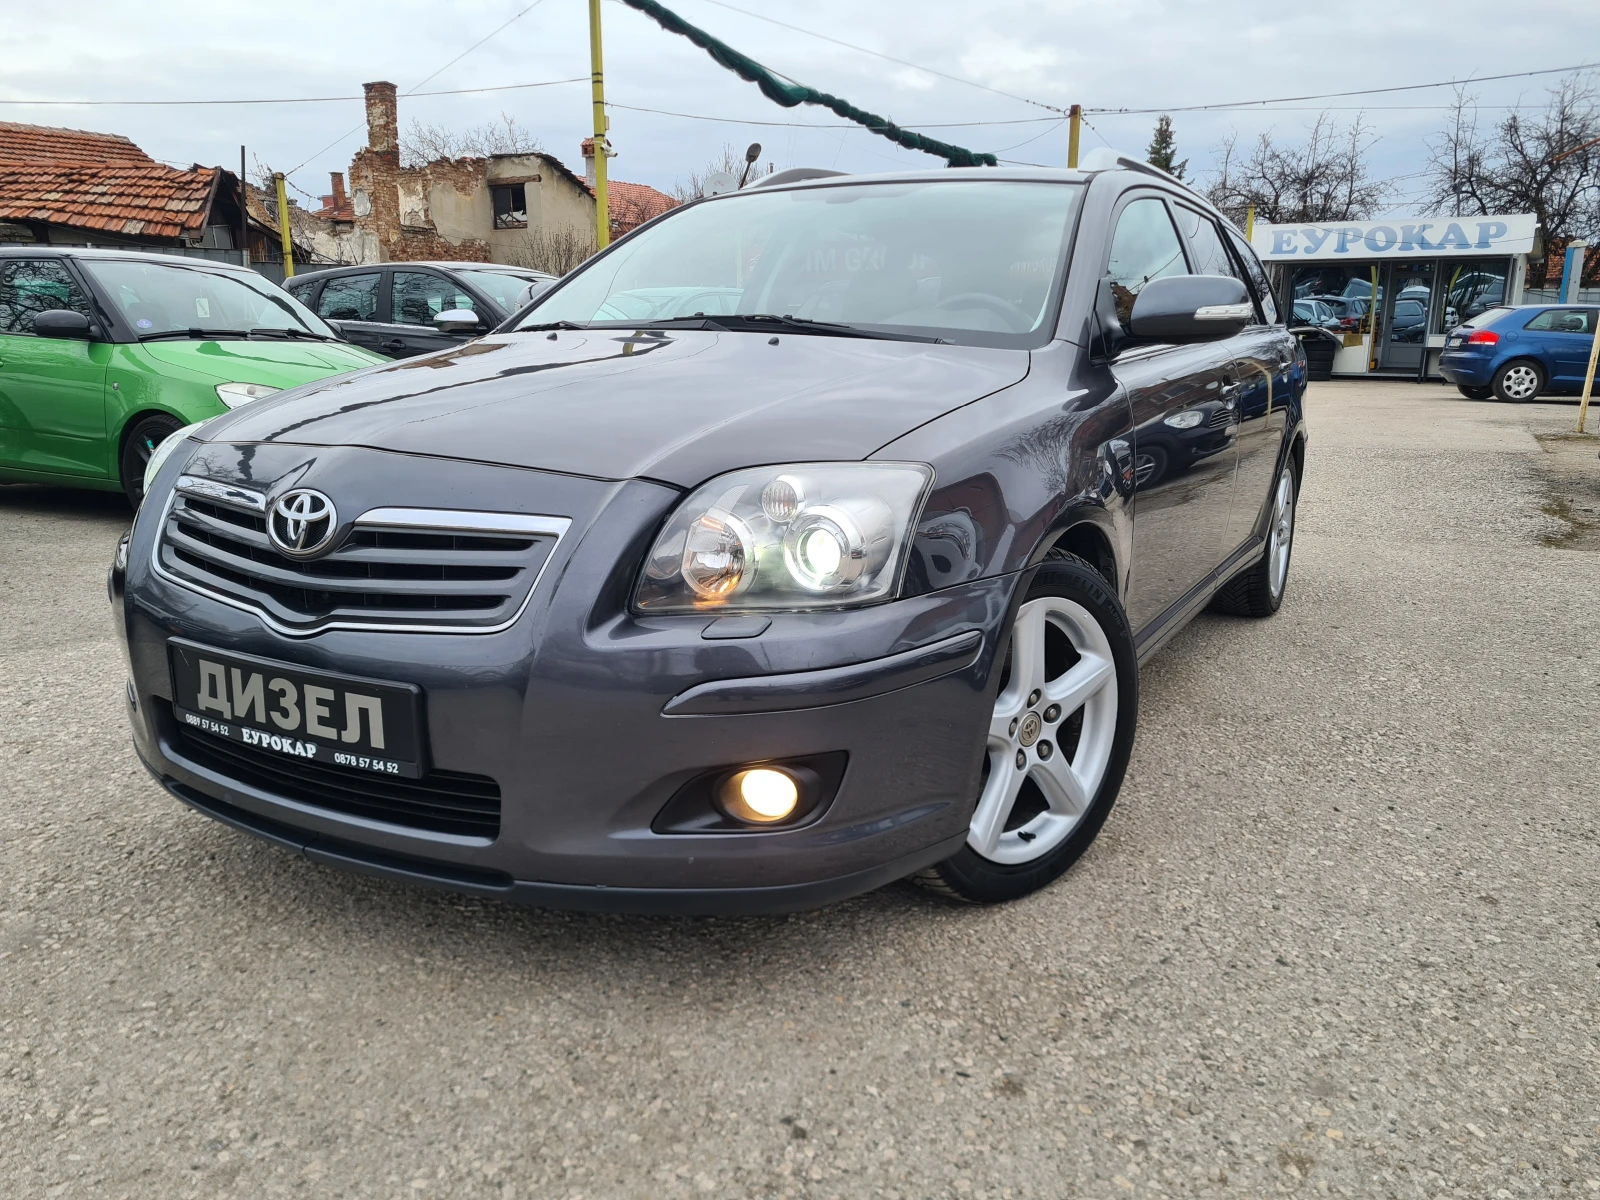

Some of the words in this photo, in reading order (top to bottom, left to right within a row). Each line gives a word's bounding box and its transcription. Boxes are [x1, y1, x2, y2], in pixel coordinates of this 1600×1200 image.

[1270, 221, 1508, 255] ЕУРОКАР
[197, 659, 385, 749] ДИЗЕЛ
[202, 719, 210, 729] 57
[211, 722, 219, 733] 54
[220, 725, 229, 736] 52
[241, 727, 317, 759] ЕУРОКАР
[334, 753, 357, 766] 0878
[359, 757, 370, 768] 57
[373, 760, 384, 771] 54
[387, 762, 399, 774] 52
